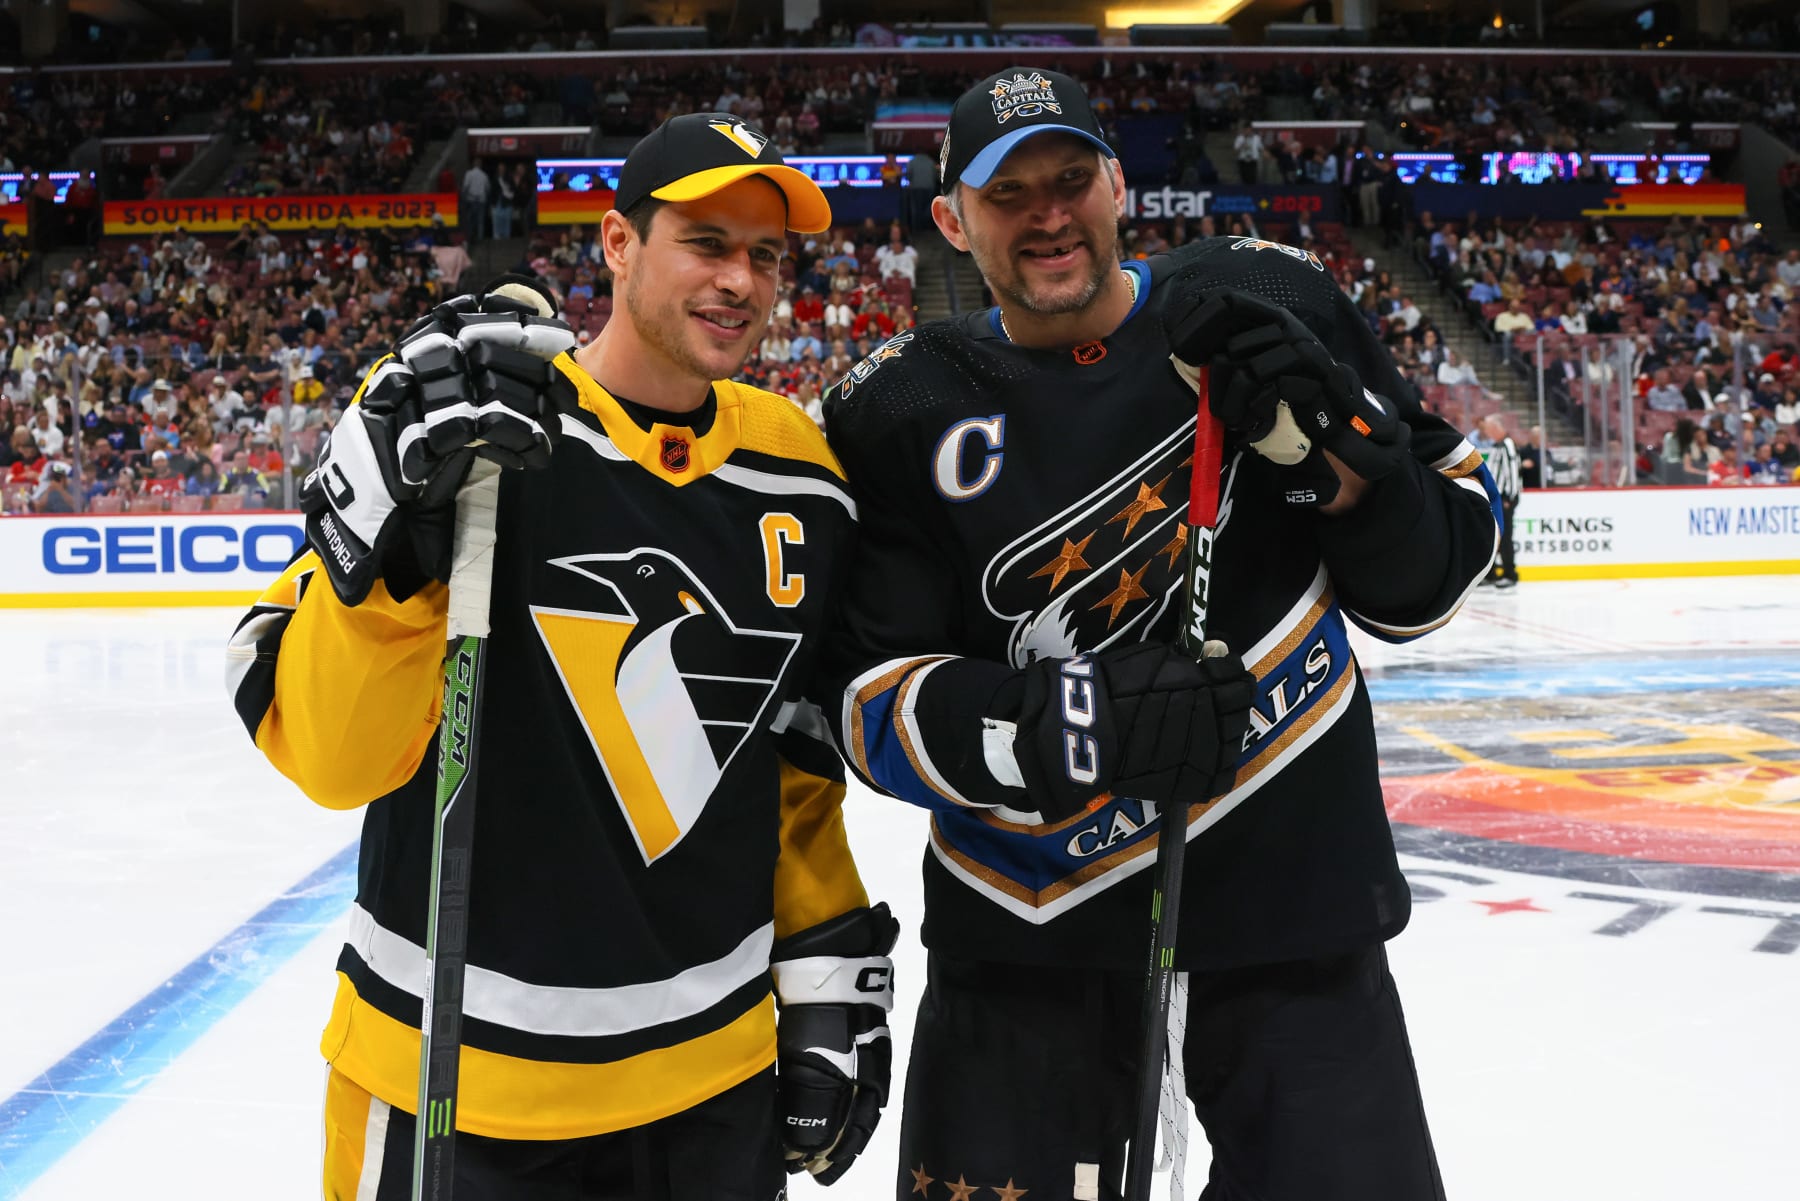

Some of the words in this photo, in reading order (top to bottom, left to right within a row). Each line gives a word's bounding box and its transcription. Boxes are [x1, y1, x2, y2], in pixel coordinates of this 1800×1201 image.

[996, 90, 1055, 109] CAPITALS
[123, 204, 219, 226] SOUTH
[231, 202, 355, 223] FLORIDA
[377, 200, 438, 220] 2023
[1141, 185, 1213, 218] star
[1271, 195, 1322, 212] 2023
[666, 446, 684, 463] NHL
[930, 413, 1006, 503] C
[1688, 507, 1732, 536] NEW
[1735, 504, 1800, 535] AMSTE
[42, 524, 306, 575] GEICO
[319, 511, 357, 576] PENGUINS
[758, 511, 806, 608] C
[1190, 526, 1214, 643] CCM
[450, 649, 474, 770] CCM
[786, 1115, 828, 1127] CCM
